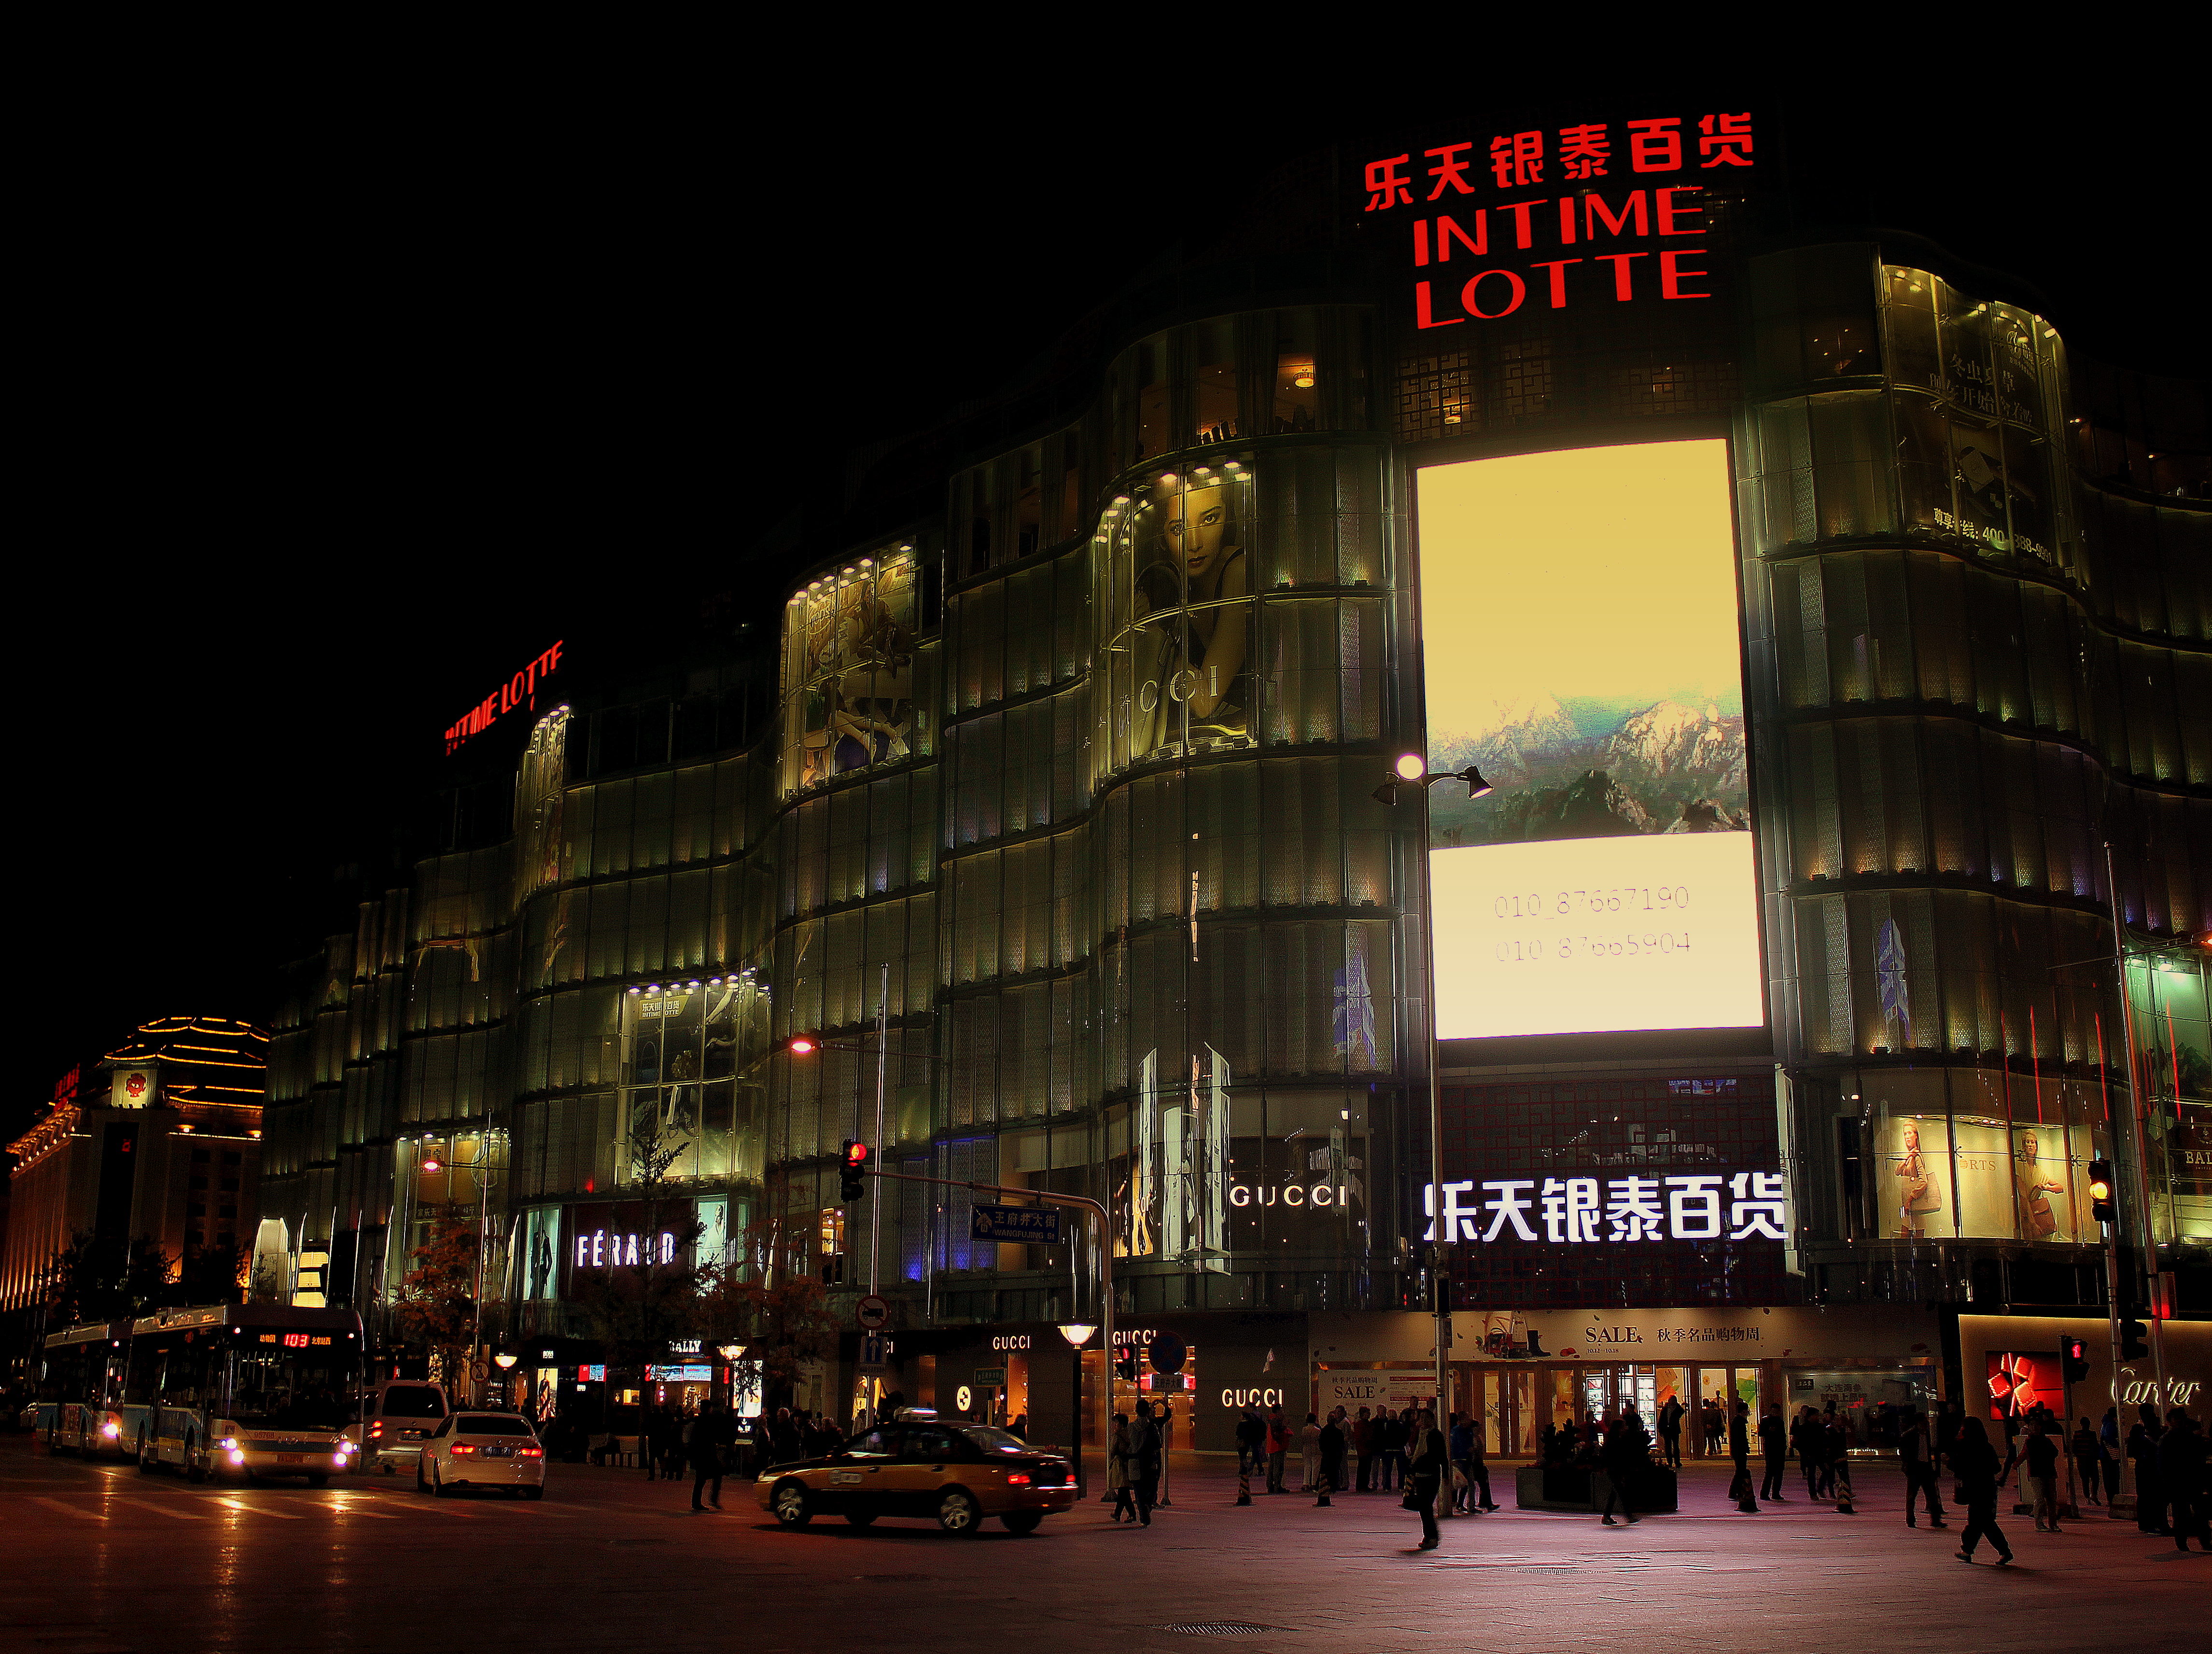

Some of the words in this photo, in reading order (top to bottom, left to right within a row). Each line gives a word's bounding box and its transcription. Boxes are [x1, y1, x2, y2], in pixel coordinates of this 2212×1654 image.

[1365, 112, 1753, 211] 乐天银泰百货
[1414, 186, 1707, 266] INTIME
[1416, 249, 1711, 329] LOTTE
[1933, 507, 1978, 540] 尊享线:
[642, 1000, 679, 1012] 乐天银百货
[1229, 1184, 1346, 1207] GUCCI
[1423, 1171, 1789, 1244] 乐天银泰百货
[994, 1211, 1056, 1228] 王府井大街
[994, 1229, 1044, 1239] WANGFUJING
[285, 1334, 309, 1347] 103
[993, 1335, 1030, 1349] GUCCI
[1585, 1326, 1638, 1343] SALE
[1657, 1326, 1759, 1343] 秋季名品购物周
[669, 1340, 701, 1353] BALLY
[1221, 1388, 1283, 1408] GUCCI
[1334, 1386, 1375, 1399] SALE
